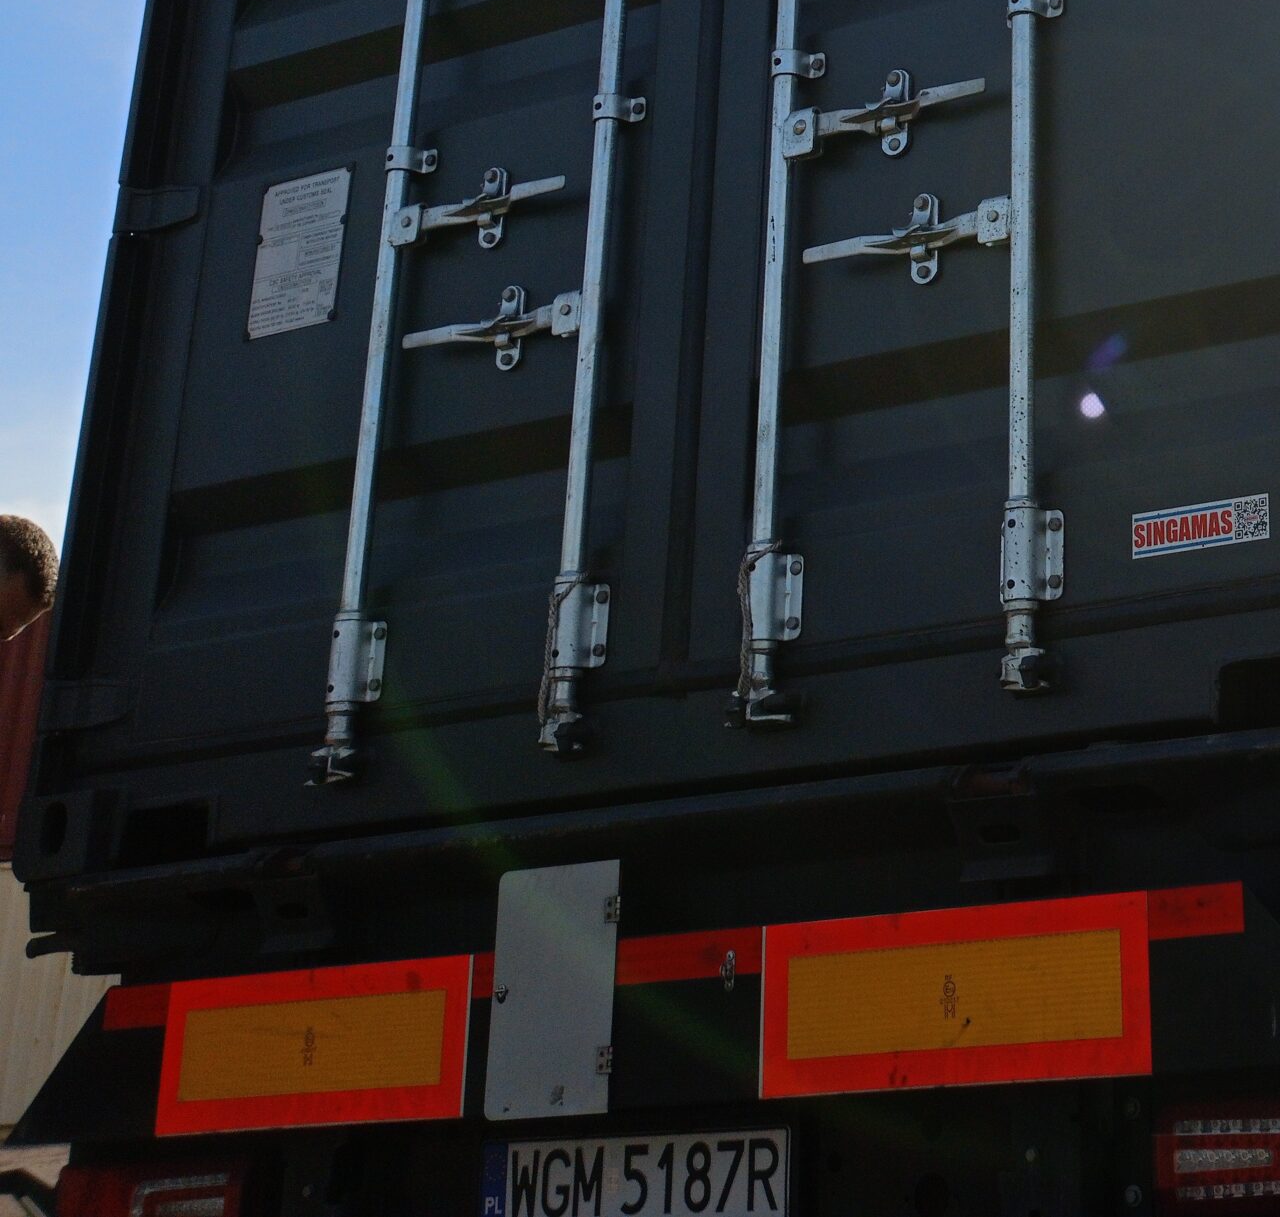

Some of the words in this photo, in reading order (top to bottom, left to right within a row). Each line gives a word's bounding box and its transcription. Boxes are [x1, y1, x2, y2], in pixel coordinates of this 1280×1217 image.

[1134, 510, 1233, 549] SINGAMAS
[512, 1145, 604, 1217] WGM
[621, 1138, 779, 1215] 5187R
[485, 1197, 502, 1215] PL
